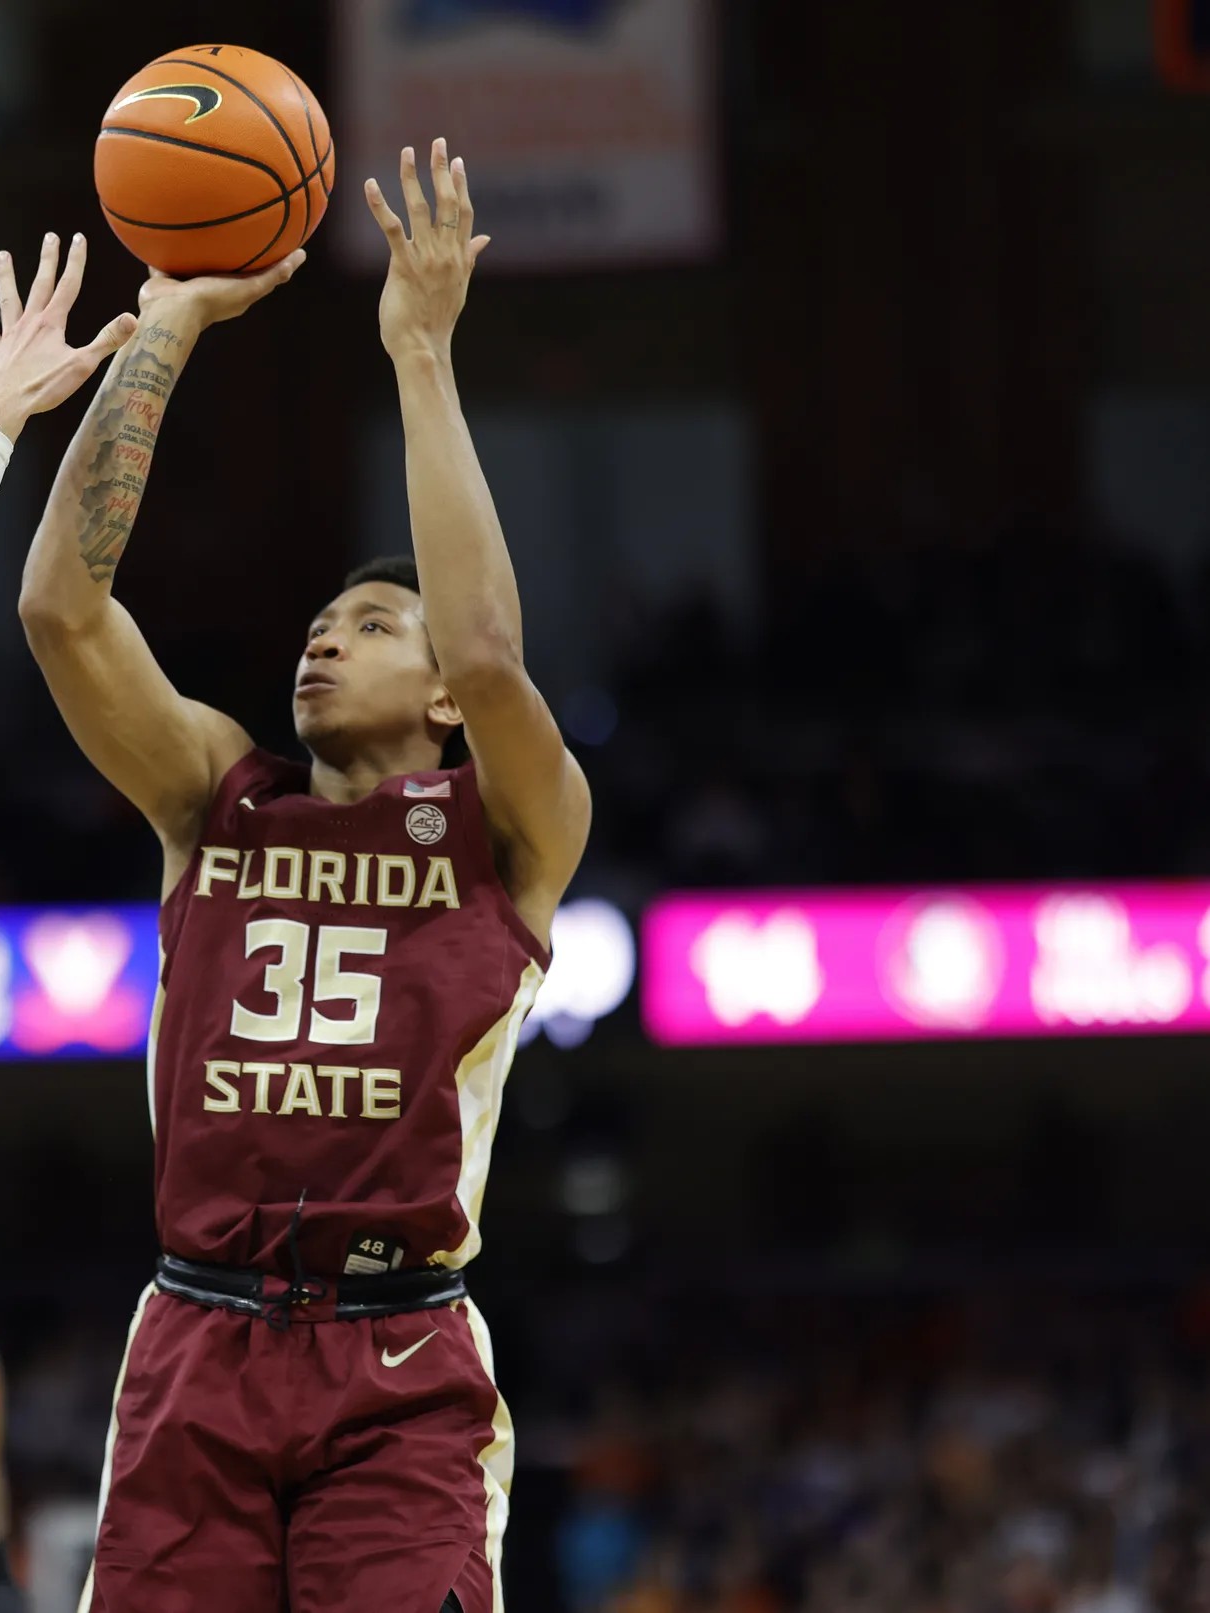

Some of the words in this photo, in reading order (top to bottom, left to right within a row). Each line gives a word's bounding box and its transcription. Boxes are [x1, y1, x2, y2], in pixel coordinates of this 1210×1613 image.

[412, 817, 442, 828] ACC
[194, 846, 461, 909] FLORIDA
[230, 918, 388, 1045] 35
[203, 1060, 402, 1119] STATE
[359, 1239, 385, 1255] 48
